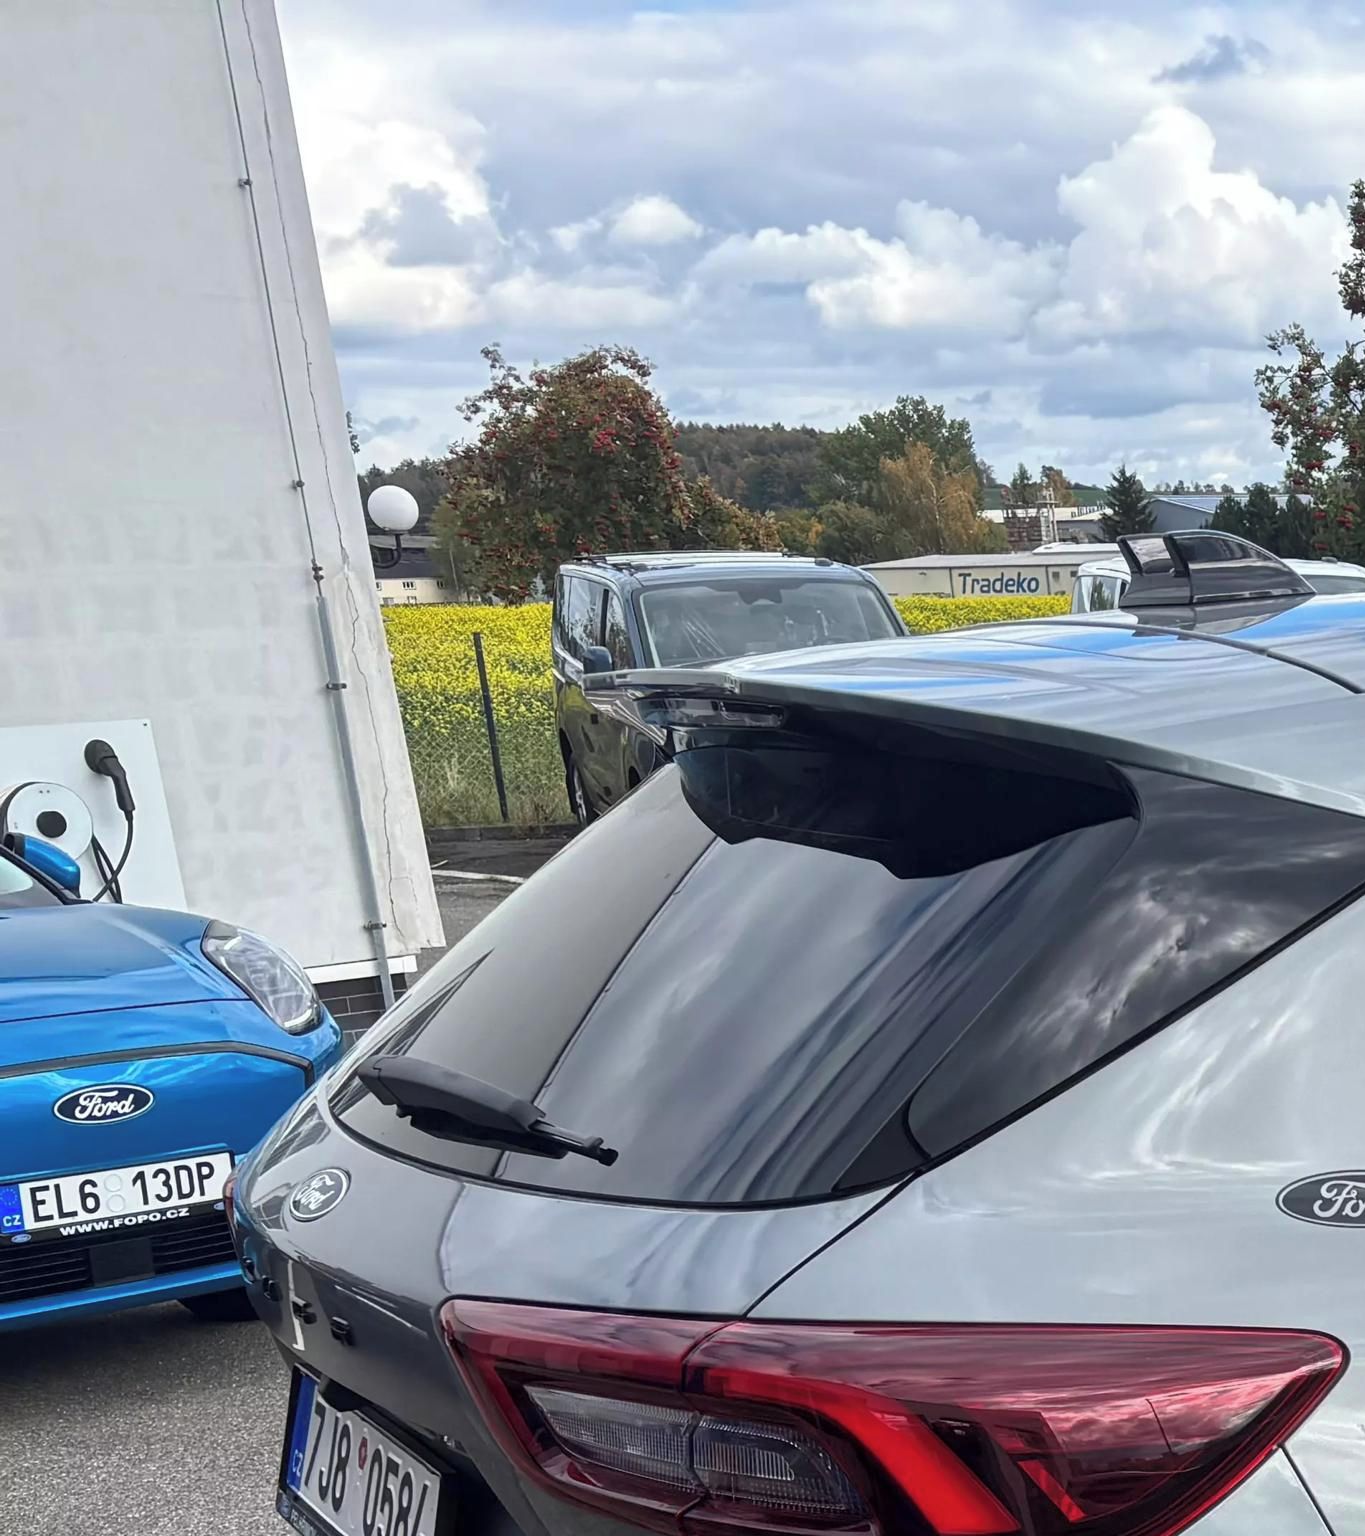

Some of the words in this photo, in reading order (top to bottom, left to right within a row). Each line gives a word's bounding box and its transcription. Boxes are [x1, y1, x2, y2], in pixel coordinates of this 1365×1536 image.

[957, 571, 1040, 595] Tradeko
[74, 1089, 136, 1120] Ford
[29, 1179, 102, 1224] EL6
[131, 1160, 216, 1207] 13DP
[2, 1213, 22, 1228] CZ
[59, 1207, 191, 1237] WWW.FOPO.CZ
[304, 1402, 352, 1514] 7J8
